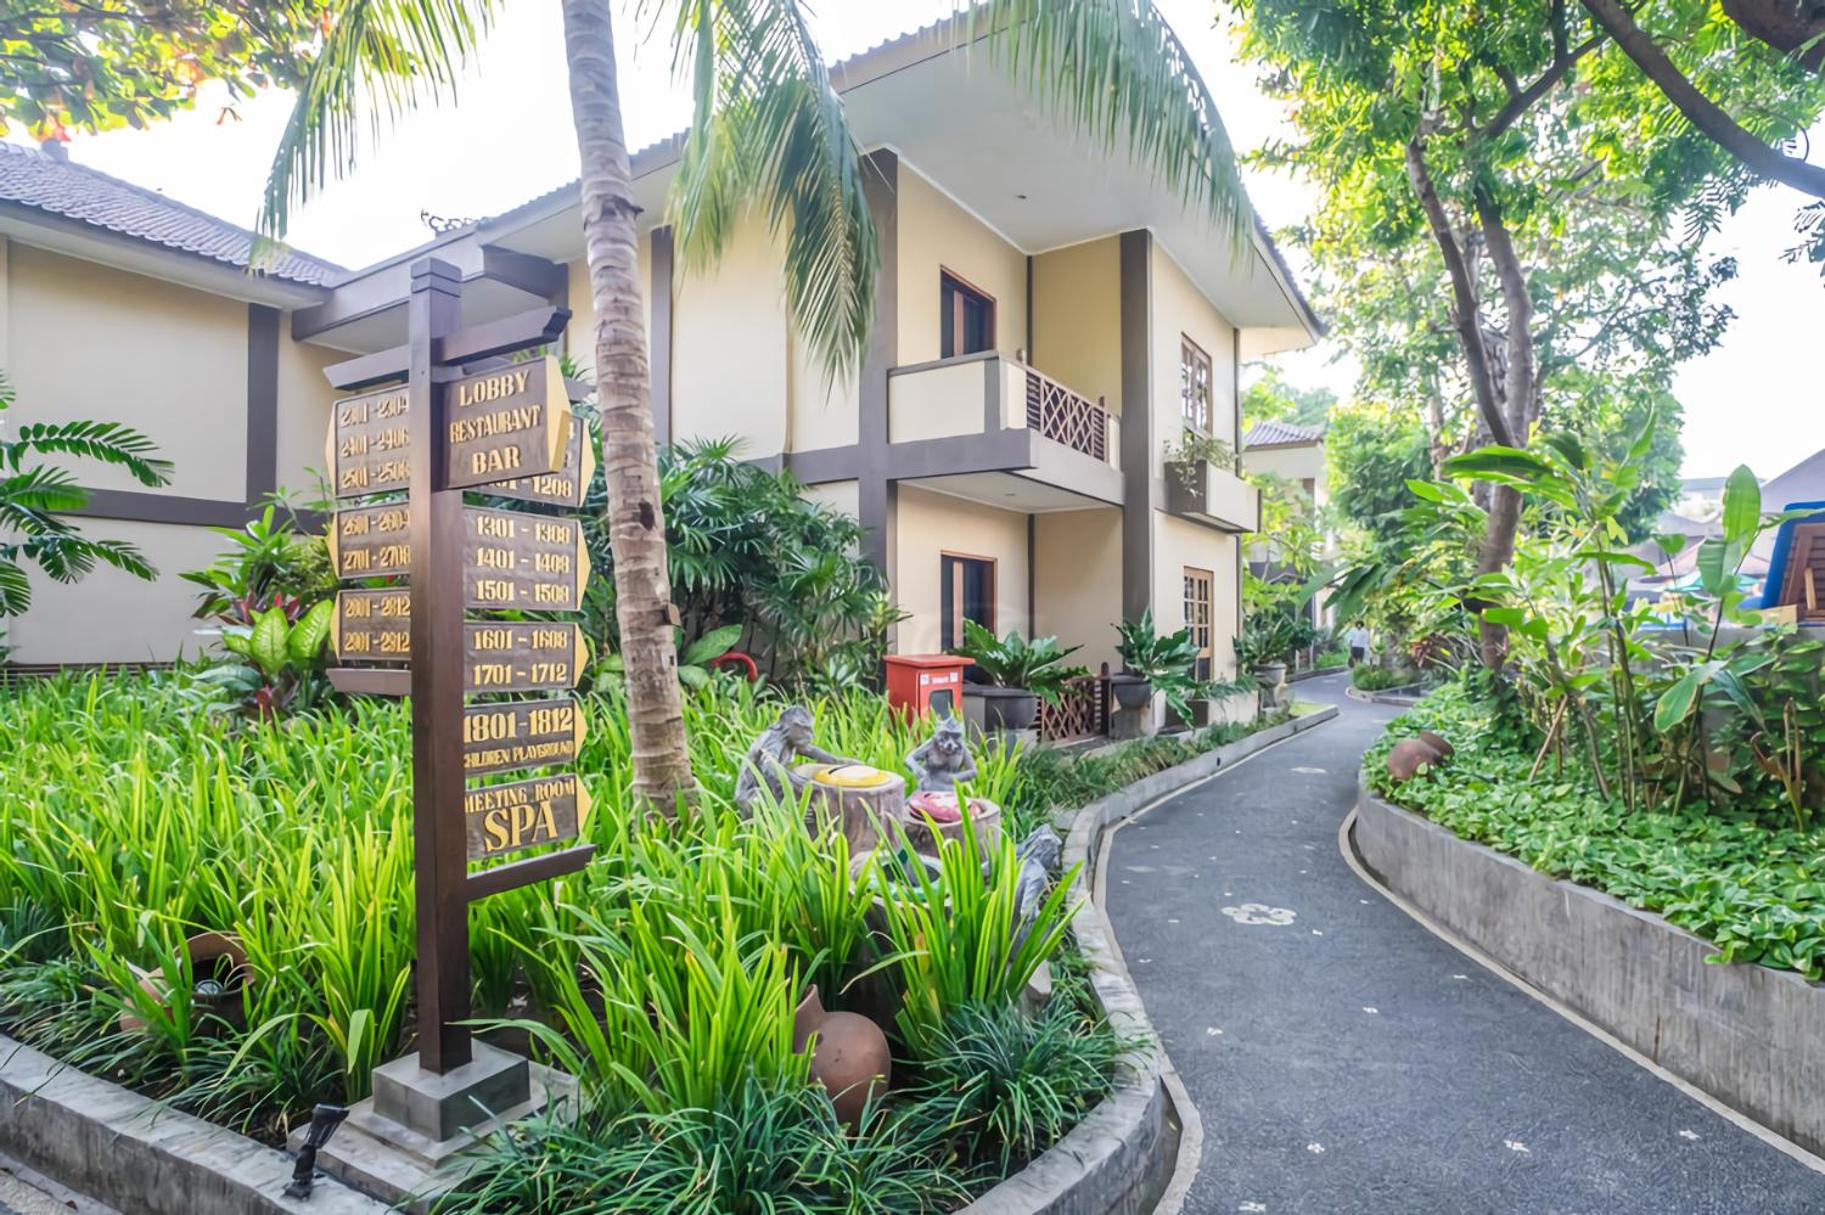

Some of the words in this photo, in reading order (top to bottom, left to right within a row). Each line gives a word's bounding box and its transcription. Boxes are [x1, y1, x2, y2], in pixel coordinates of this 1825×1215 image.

[459, 369, 530, 407] LOBBY
[449, 404, 541, 444] RESTAURANT
[471, 446, 521, 475] BAR
[473, 664, 513, 685] 1701
[531, 663, 568, 684] 1712
[512, 740, 574, 763] PLAYGROUND
[532, 778, 575, 803] ROOM
[484, 800, 558, 852] SPA
